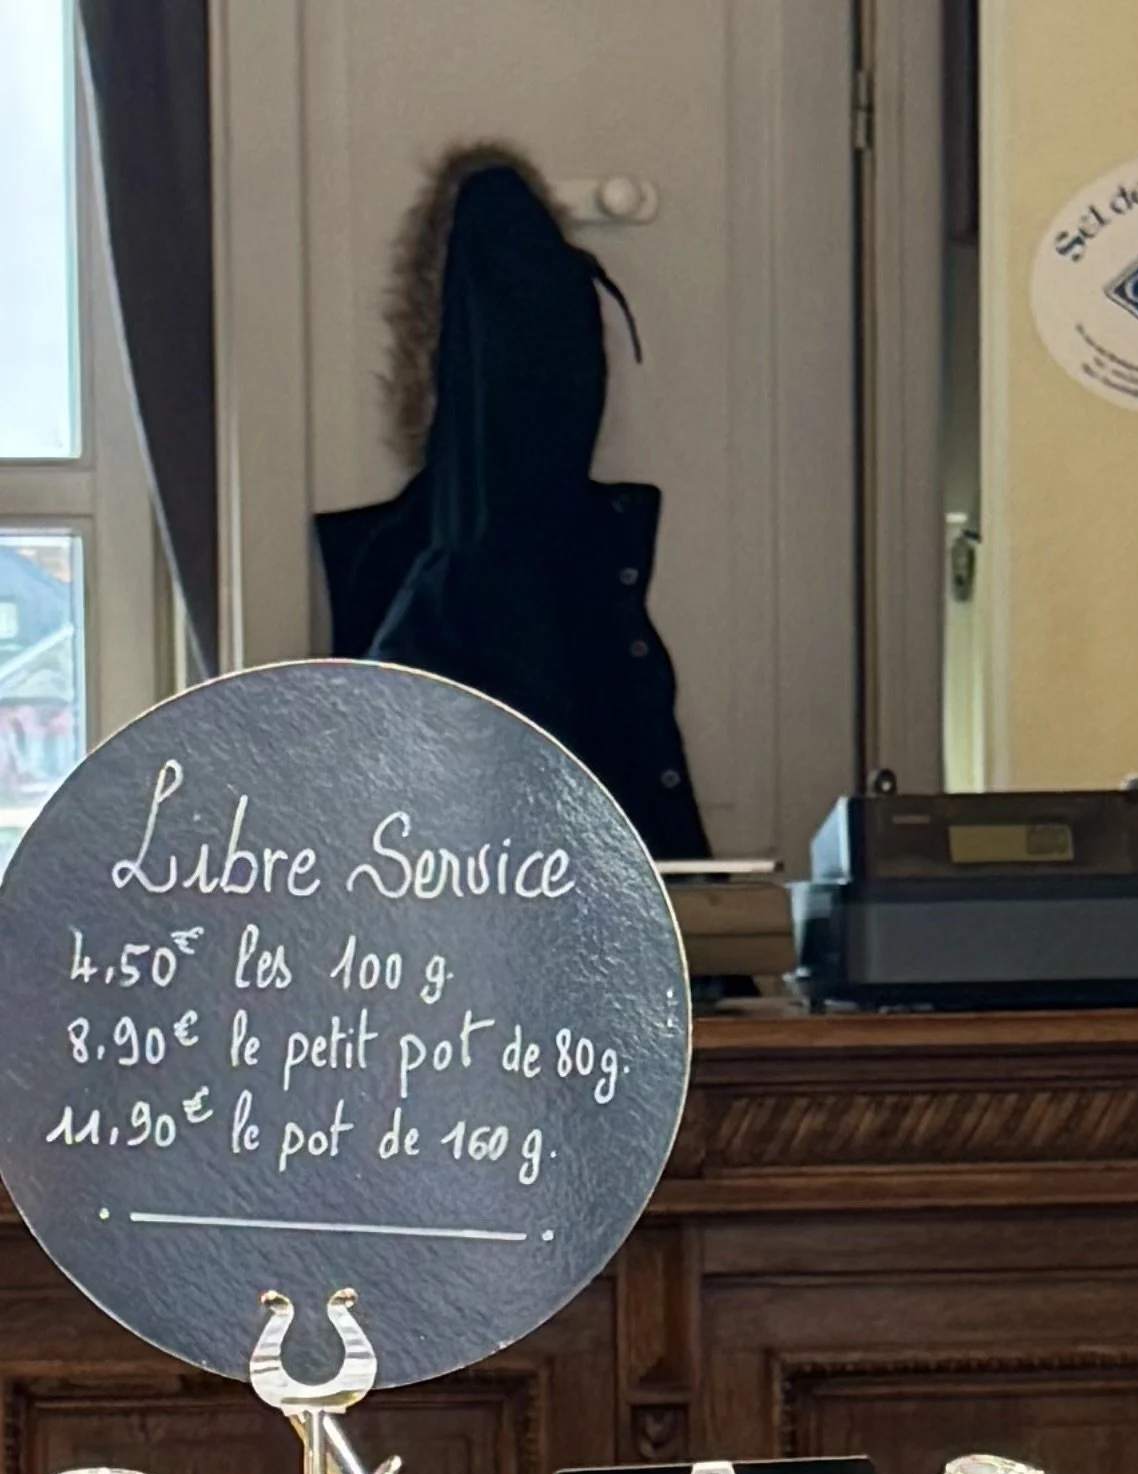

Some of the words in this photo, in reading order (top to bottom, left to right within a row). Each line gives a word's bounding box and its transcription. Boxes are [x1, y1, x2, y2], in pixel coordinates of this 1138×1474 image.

[1055, 205, 1112, 263] Sel
[112, 759, 320, 894] Libre
[347, 811, 576, 899] Service
[234, 923, 293, 988] les
[330, 935, 402, 990] 100
[230, 1009, 261, 1067] le
[283, 1008, 379, 1091] petit
[400, 1010, 496, 1099] pot
[502, 1024, 542, 1078] de
[232, 1089, 261, 1154] le
[280, 1099, 354, 1171] pot
[379, 1107, 420, 1159] de
[441, 1121, 509, 1161] 160
